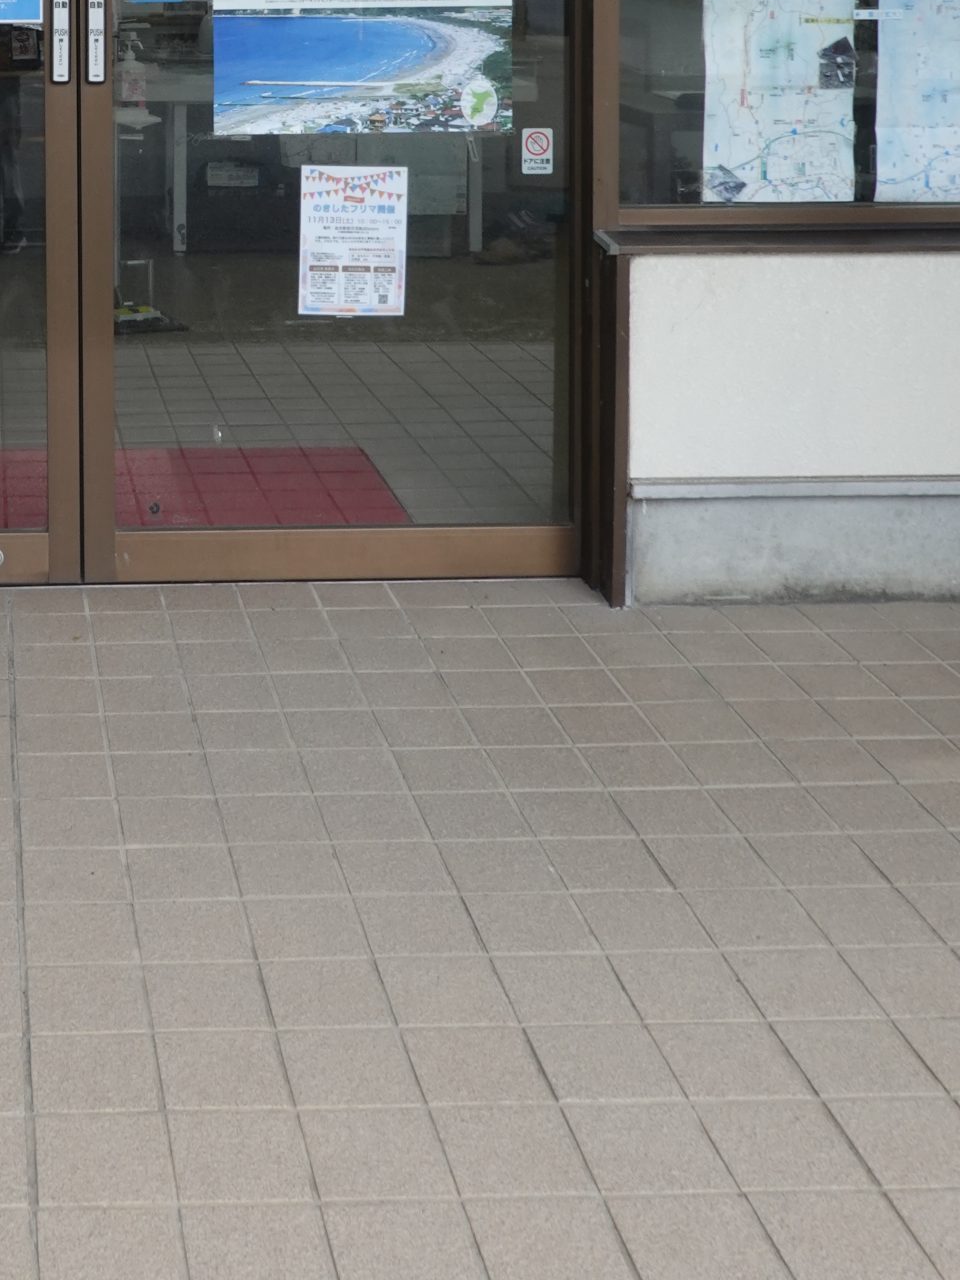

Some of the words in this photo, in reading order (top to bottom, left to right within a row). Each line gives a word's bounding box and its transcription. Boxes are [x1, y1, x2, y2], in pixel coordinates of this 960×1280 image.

[54, 1, 68, 9] 自動
[89, 1, 103, 9] 自動
[55, 28, 67, 36] PUSH
[90, 28, 102, 36] PUSH
